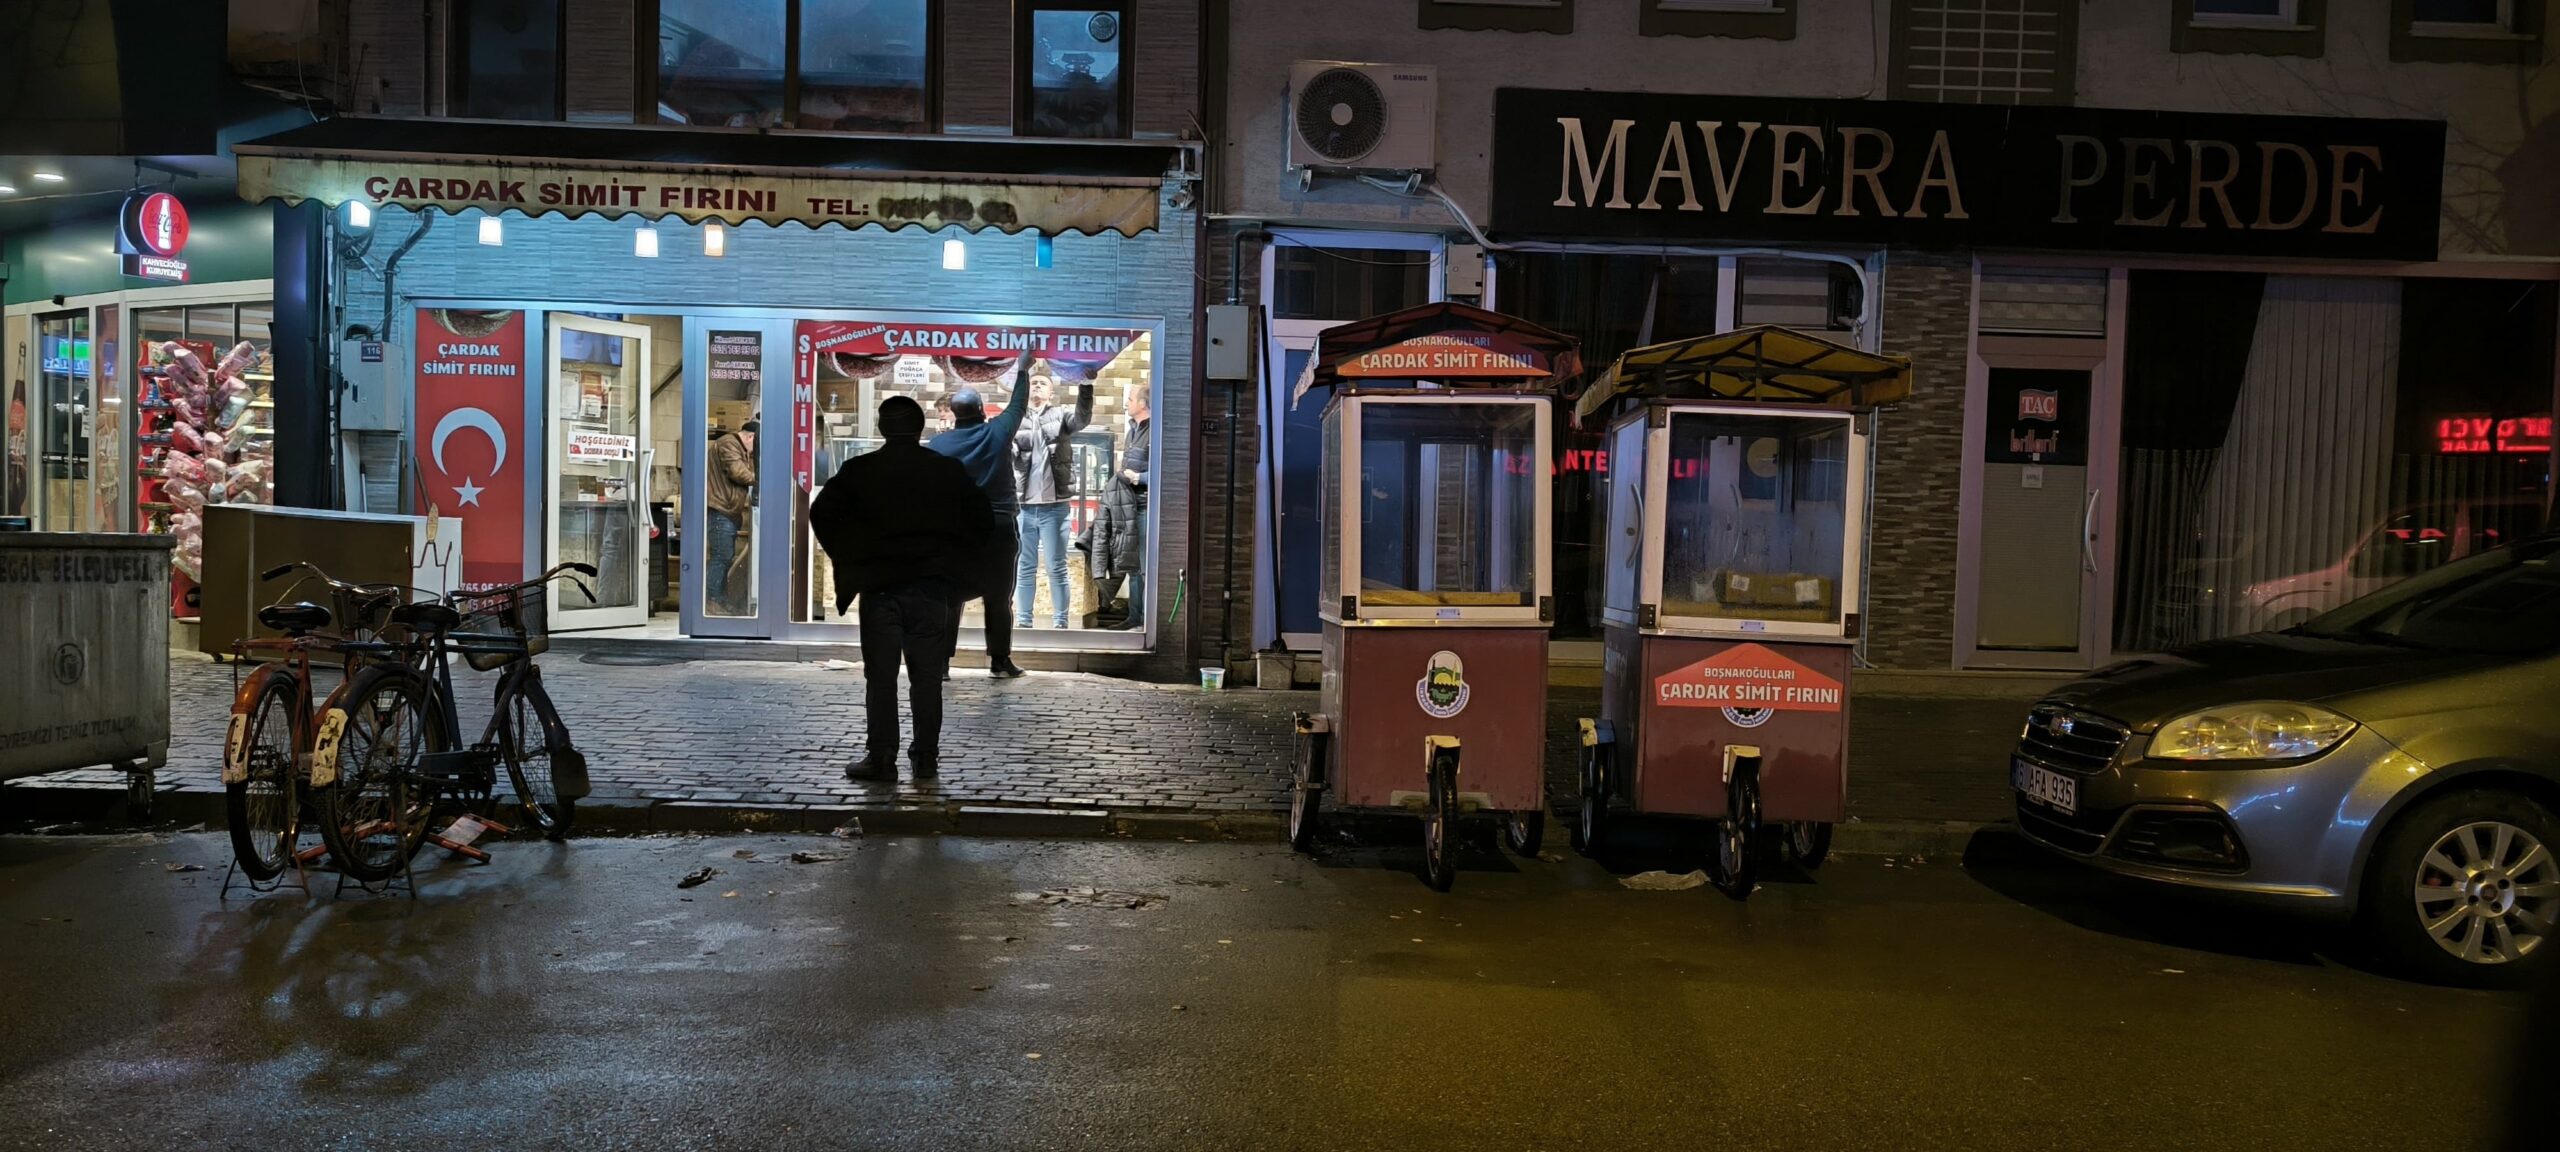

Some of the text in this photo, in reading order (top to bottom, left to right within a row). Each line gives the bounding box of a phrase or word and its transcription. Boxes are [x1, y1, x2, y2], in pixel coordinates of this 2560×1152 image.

[1392, 74, 1428, 82] SAMSUNG
[1553, 116, 2384, 234] MAVERA PERDE
[364, 177, 525, 203] ÇARDAK
[538, 177, 646, 206] SİMİT
[660, 186, 776, 213] FIRINI
[807, 198, 869, 215] TEL:
[438, 343, 500, 358] ÇARDAK
[884, 329, 1129, 353] ÇARDAK SİMİT FIRINI
[423, 360, 516, 376] SİMİT FIRINI
[1360, 350, 1532, 372] ÇARDAK SİMİT FIRINI
[575, 435, 630, 447] HOŞGELDİNİZ
[1704, 667, 1794, 680] BOŞNAKOĞULLARI
[1661, 682, 1838, 704] ÇARDAK SİMİT FIRINI
[2029, 767, 2047, 797] AFA
[2052, 776, 2073, 806] 935
